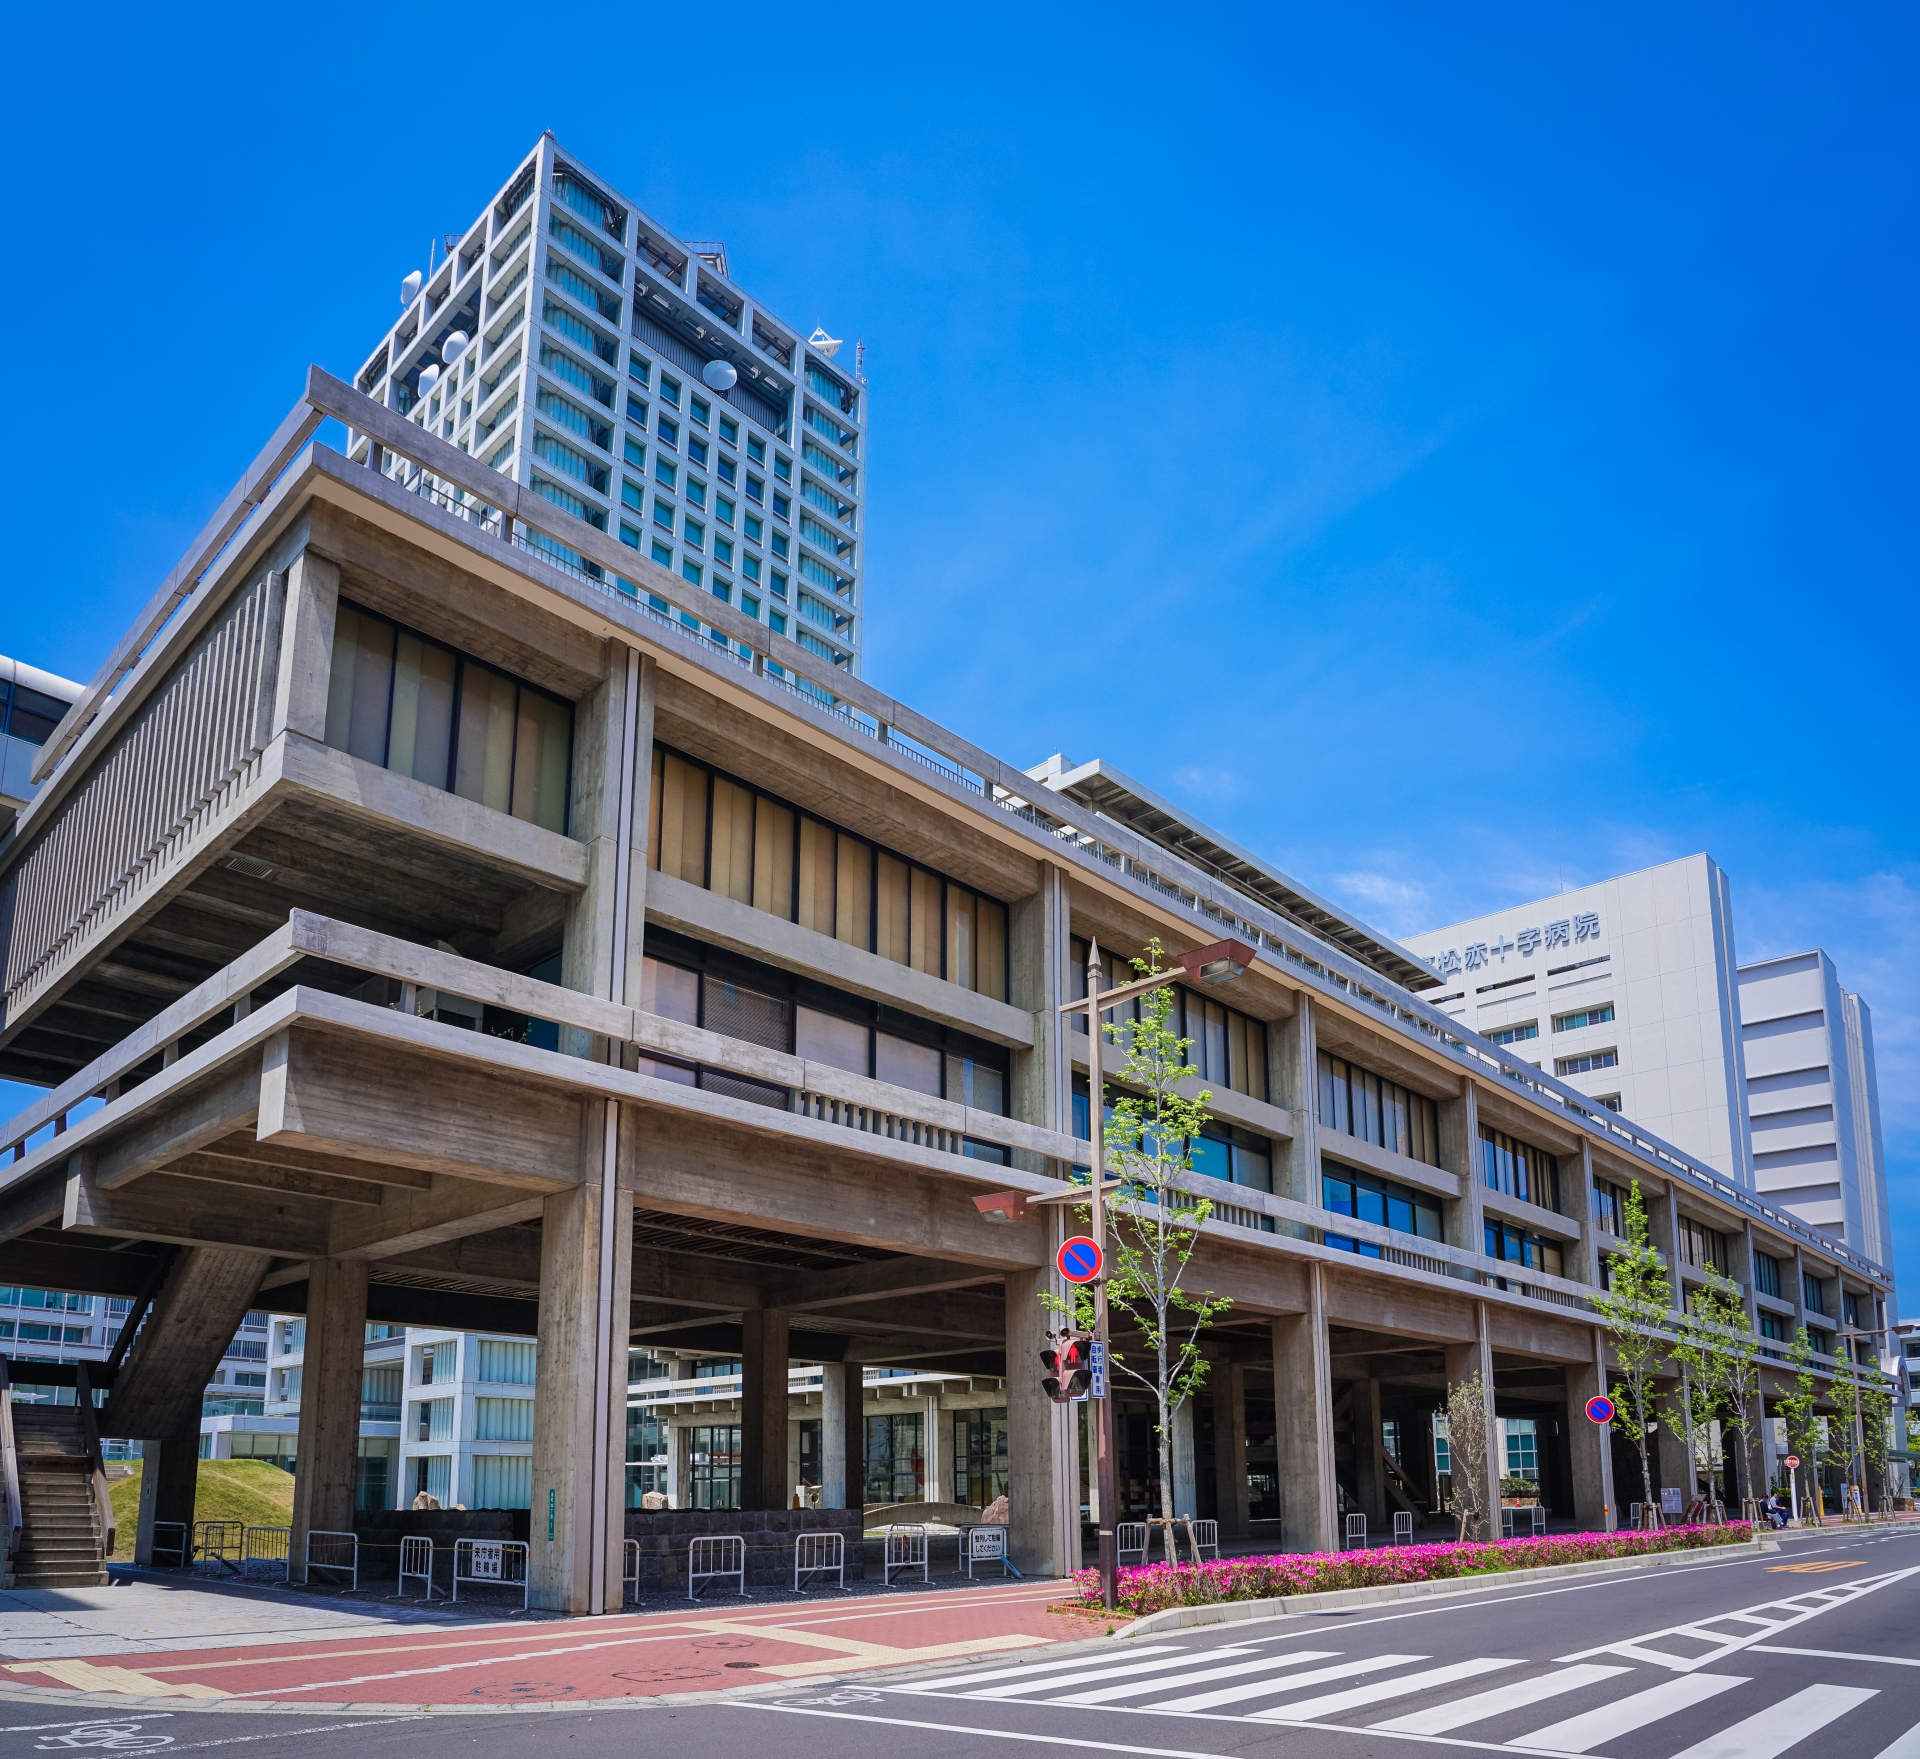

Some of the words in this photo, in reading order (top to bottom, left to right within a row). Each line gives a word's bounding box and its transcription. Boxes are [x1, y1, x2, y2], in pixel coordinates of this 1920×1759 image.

[474, 1547, 500, 1559] 来庁者用
[976, 1544, 1000, 1553] してください
